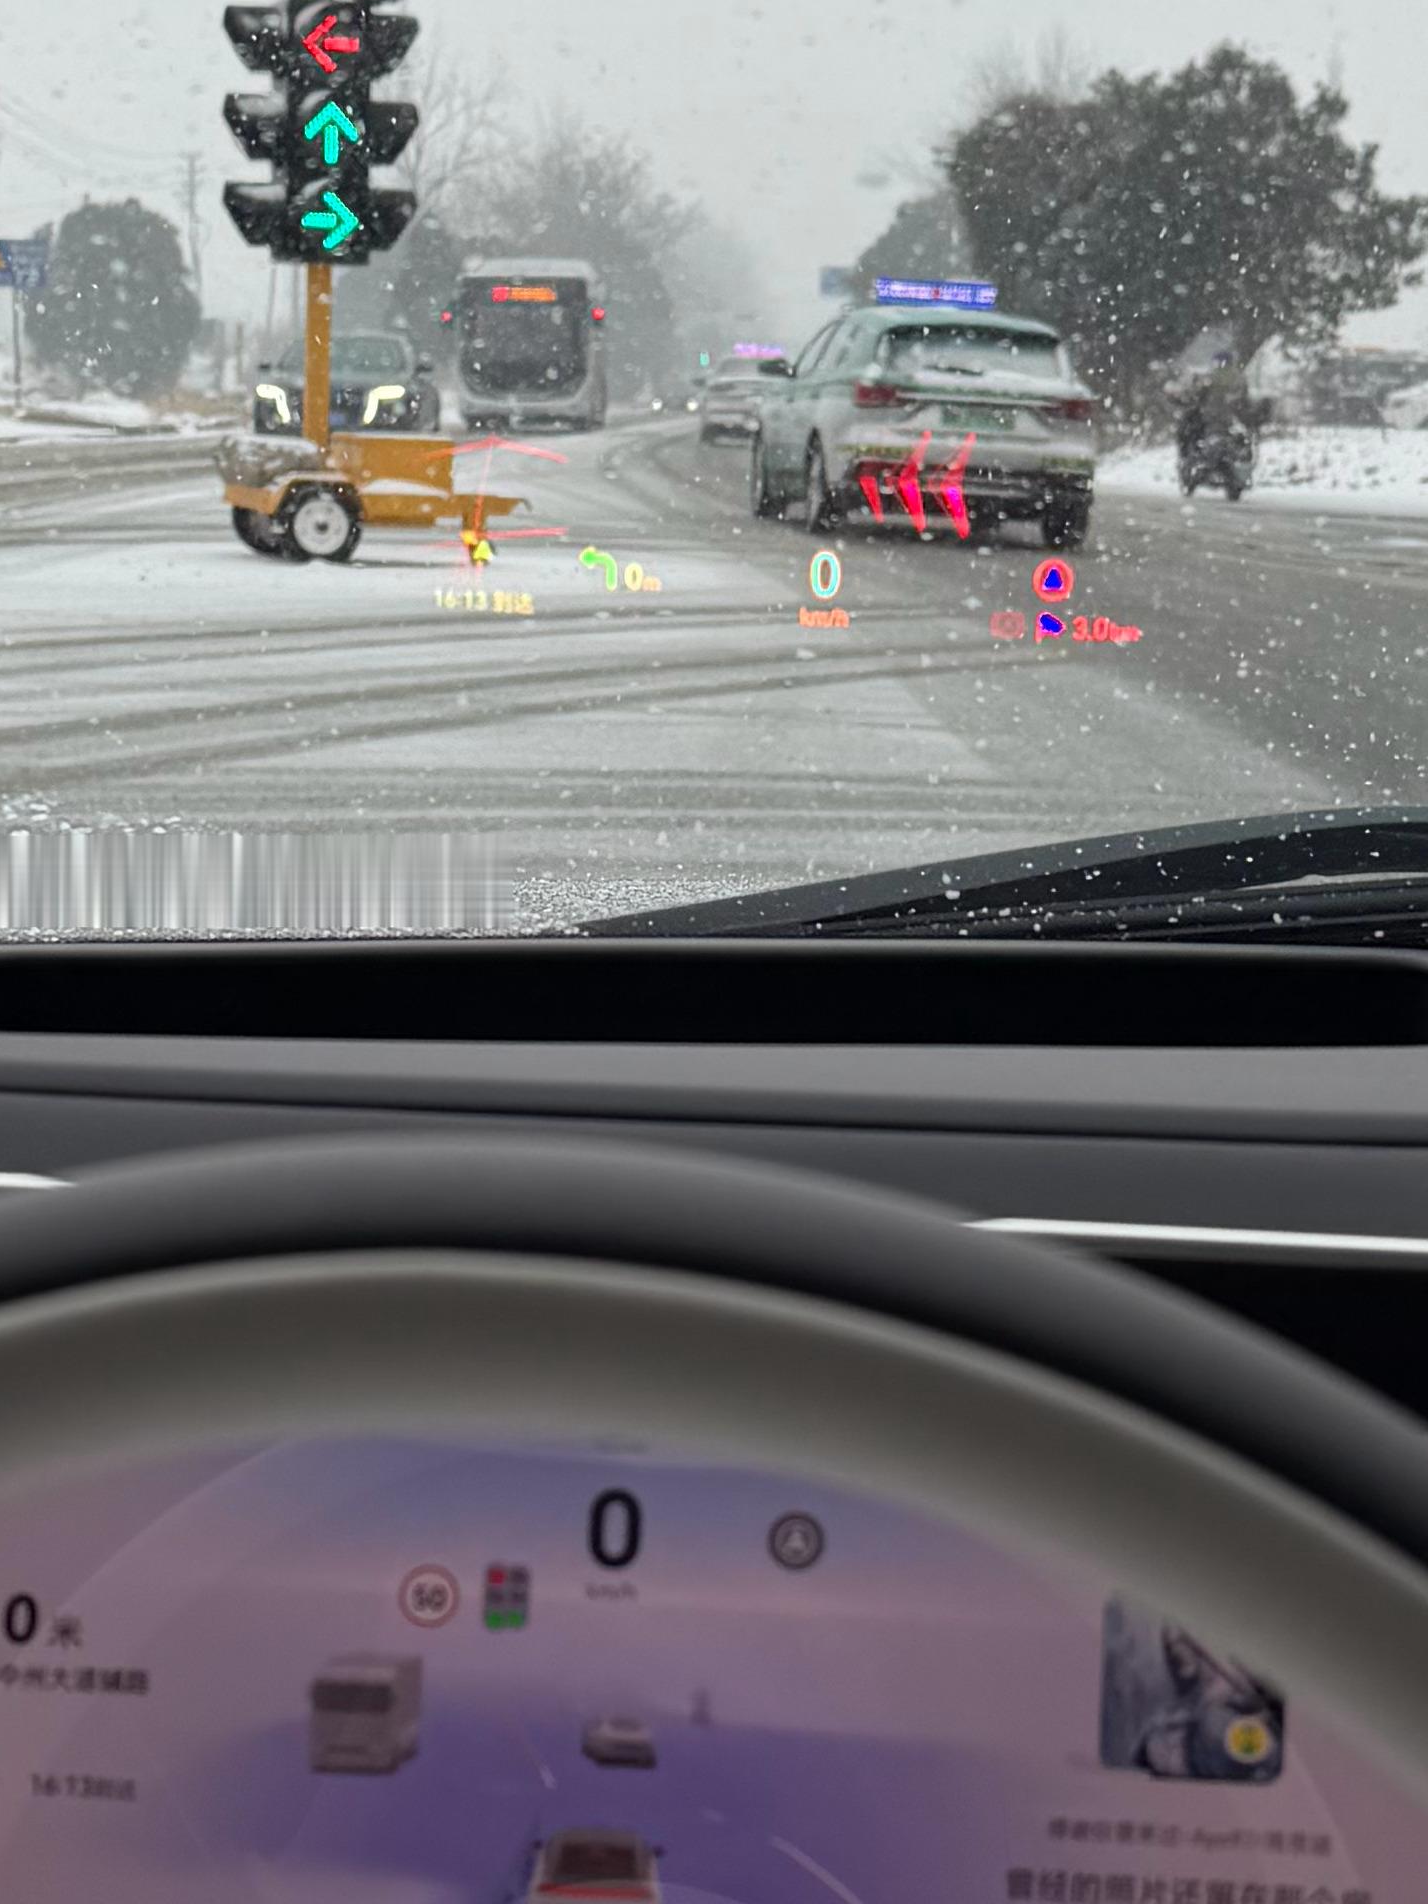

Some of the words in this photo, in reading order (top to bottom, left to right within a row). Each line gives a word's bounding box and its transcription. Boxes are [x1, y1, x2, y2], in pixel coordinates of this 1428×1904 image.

[809, 550, 841, 599] 0
[586, 1488, 644, 1571] 0
[3, 1591, 40, 1647] 0
[46, 1614, 84, 1650] 米
